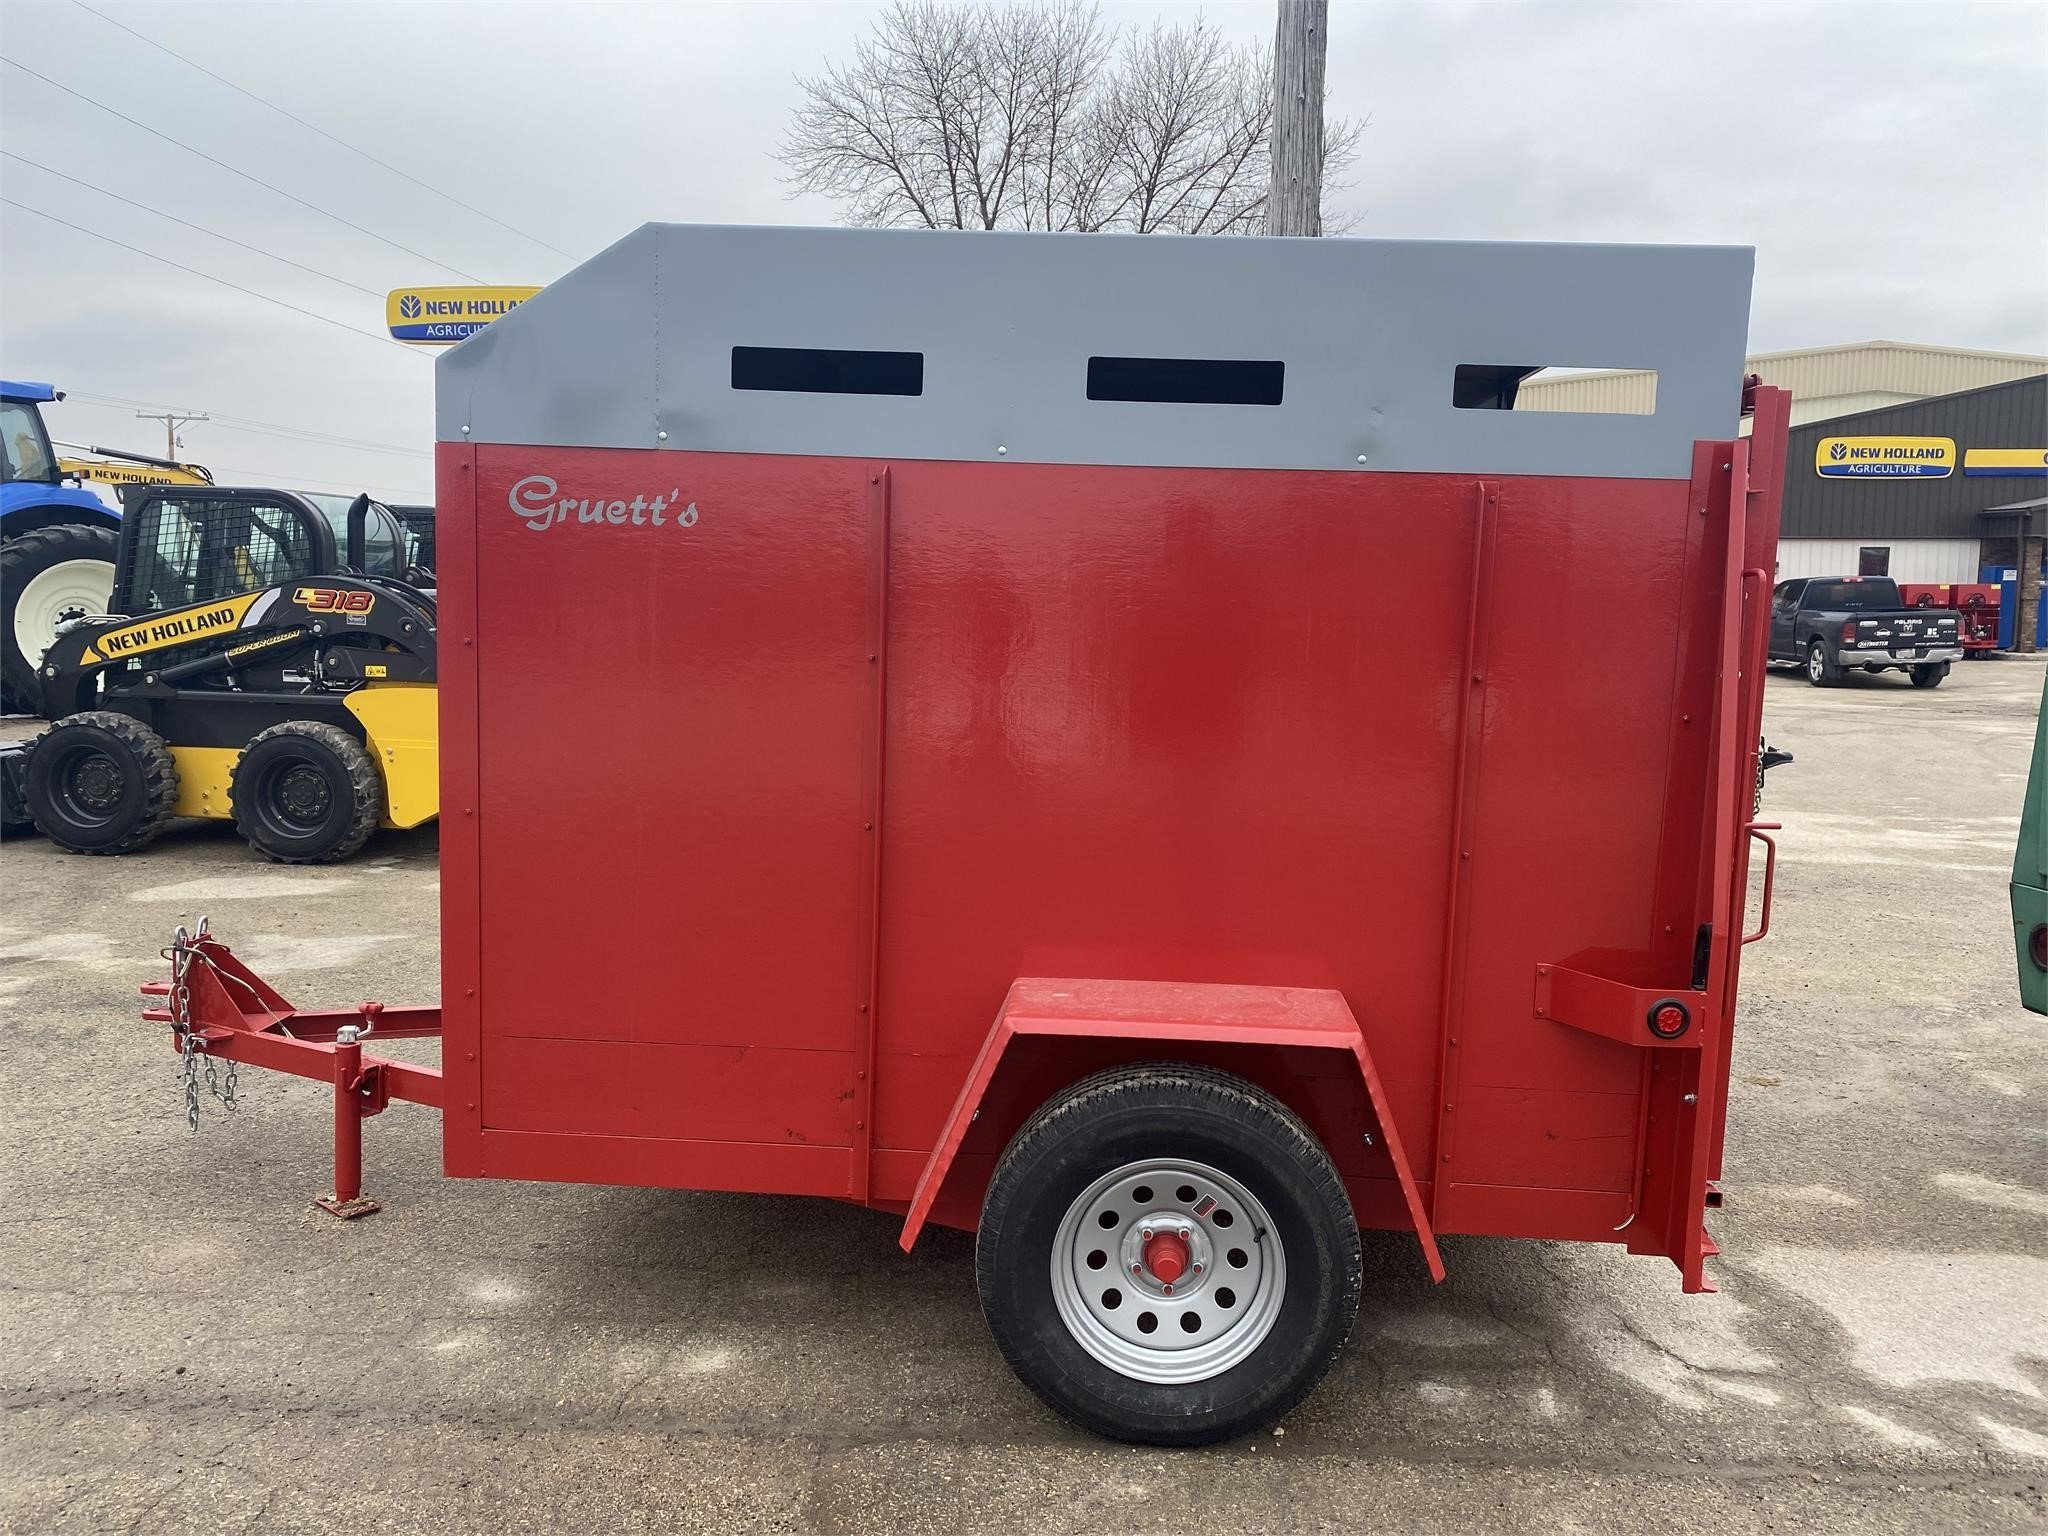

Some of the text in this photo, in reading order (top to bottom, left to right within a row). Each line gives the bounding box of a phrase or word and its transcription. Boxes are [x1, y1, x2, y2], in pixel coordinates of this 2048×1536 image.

[426, 300, 523, 315] NEW HOLLA
[1850, 448, 1945, 459] NEW HOLLAND
[95, 470, 172, 485] NEW HOLLAND
[1848, 465, 1922, 474] AGRICULTURE
[508, 475, 699, 531] Gruett's
[293, 587, 376, 615] L318
[107, 608, 235, 653] NEW HOLLAND
[229, 639, 267, 657] SUPER
